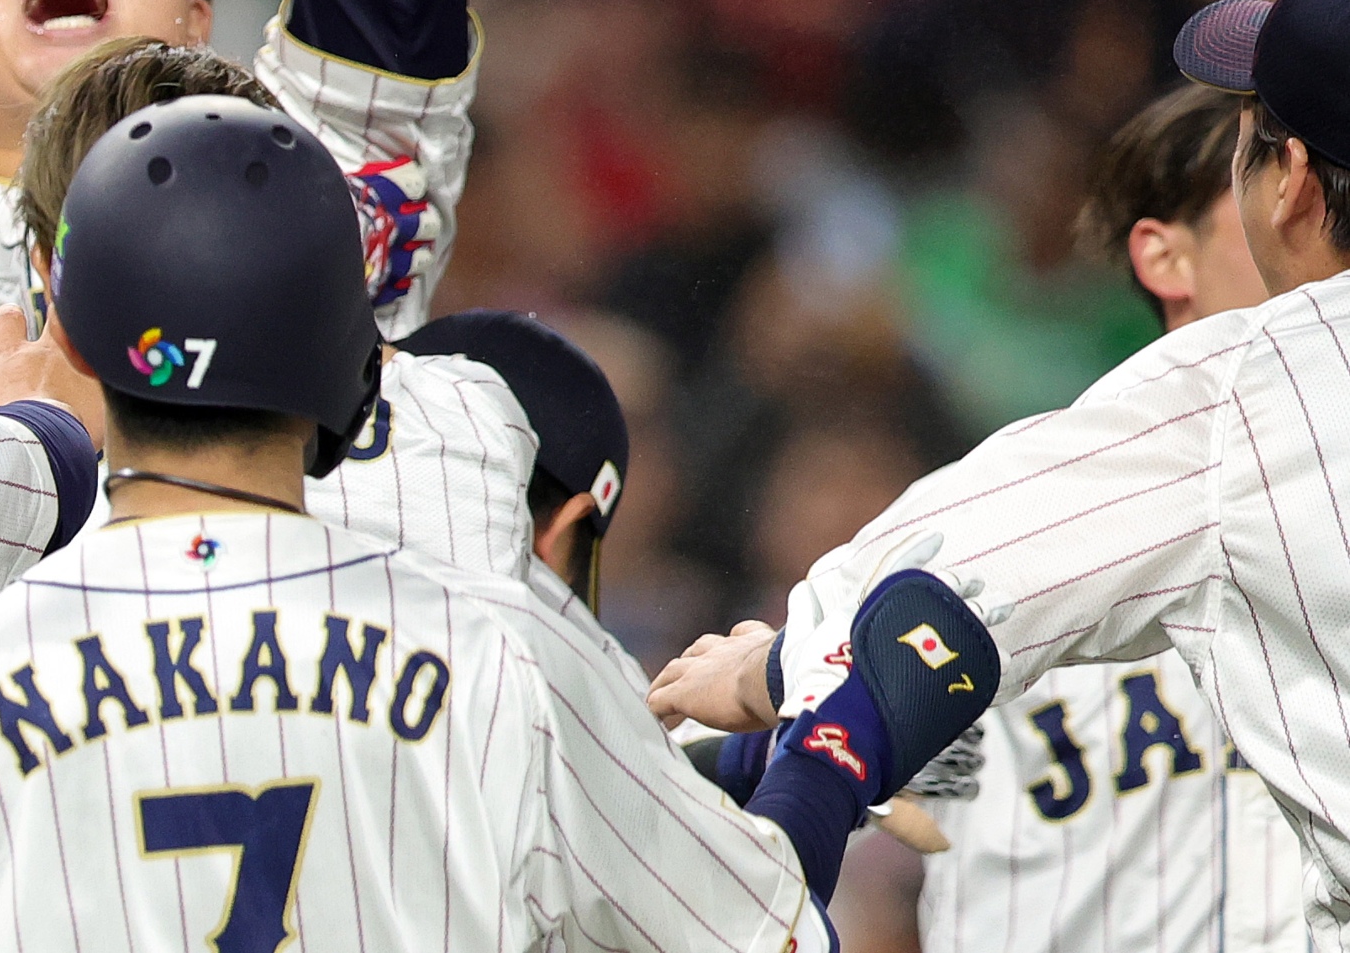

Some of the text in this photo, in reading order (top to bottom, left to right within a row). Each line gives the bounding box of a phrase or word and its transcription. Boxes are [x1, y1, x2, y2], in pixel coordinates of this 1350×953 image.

[184, 338, 217, 389] 7
[1024, 667, 1262, 824] JA
[133, 776, 322, 953] 7
